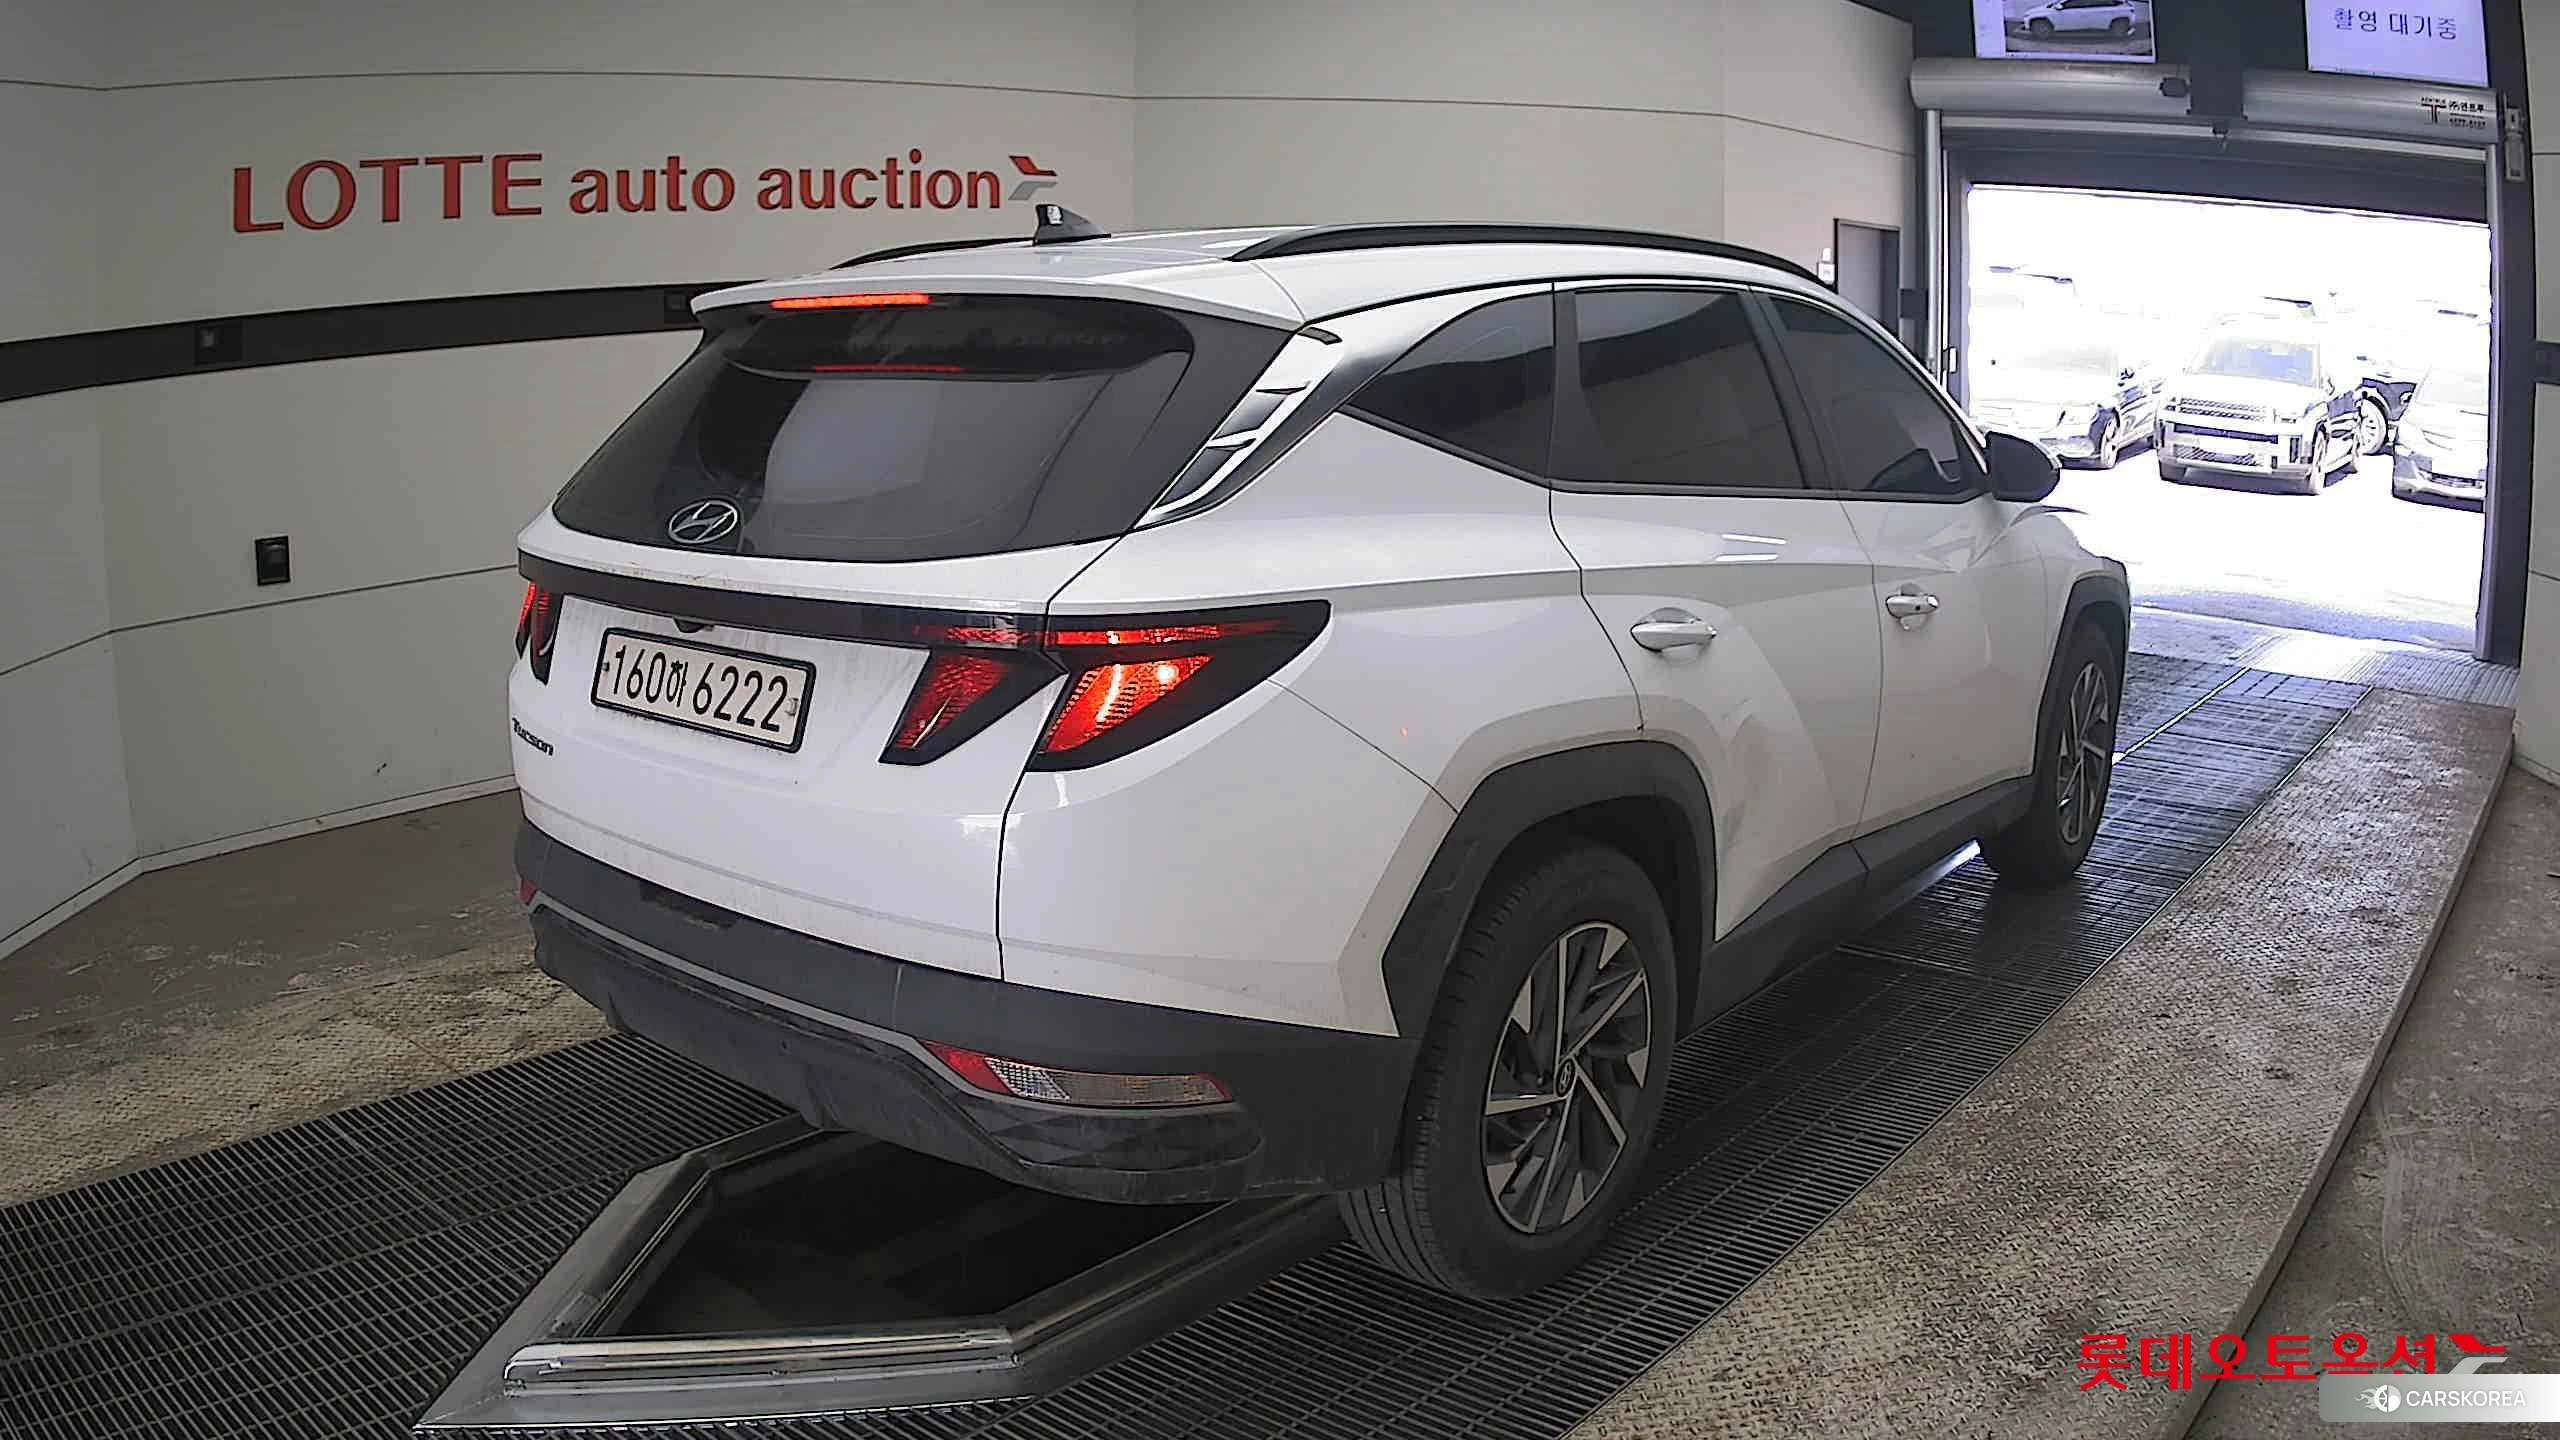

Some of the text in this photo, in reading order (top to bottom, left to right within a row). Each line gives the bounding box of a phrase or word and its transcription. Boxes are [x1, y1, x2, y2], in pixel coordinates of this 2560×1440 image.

[233, 149, 1005, 234] LOTTE auto auction
[691, 660, 788, 734] 6222
